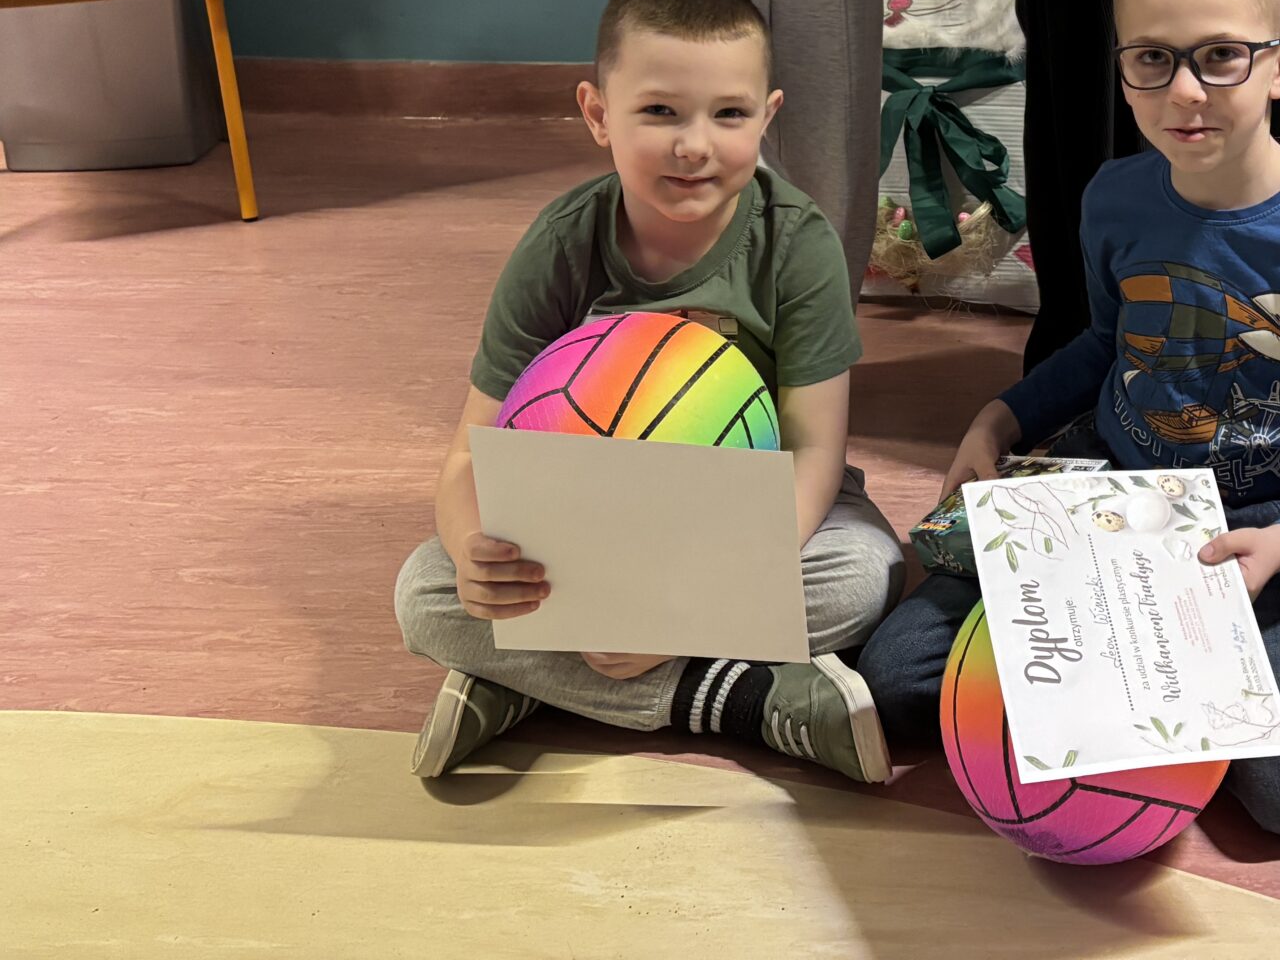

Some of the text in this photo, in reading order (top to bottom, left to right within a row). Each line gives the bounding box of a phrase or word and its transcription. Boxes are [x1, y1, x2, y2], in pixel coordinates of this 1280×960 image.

[1110, 558, 1131, 604] plastycznym
[1011, 579, 1083, 685] Dyplom
[1065, 600, 1083, 647] otrzymuje:
[1122, 606, 1139, 644] konkursie
[1129, 549, 1181, 702] Wielkanocne Tradycje
[1099, 635, 1122, 669] Leon
[1133, 654, 1147, 678] udział
[1142, 681, 1151, 690] za
